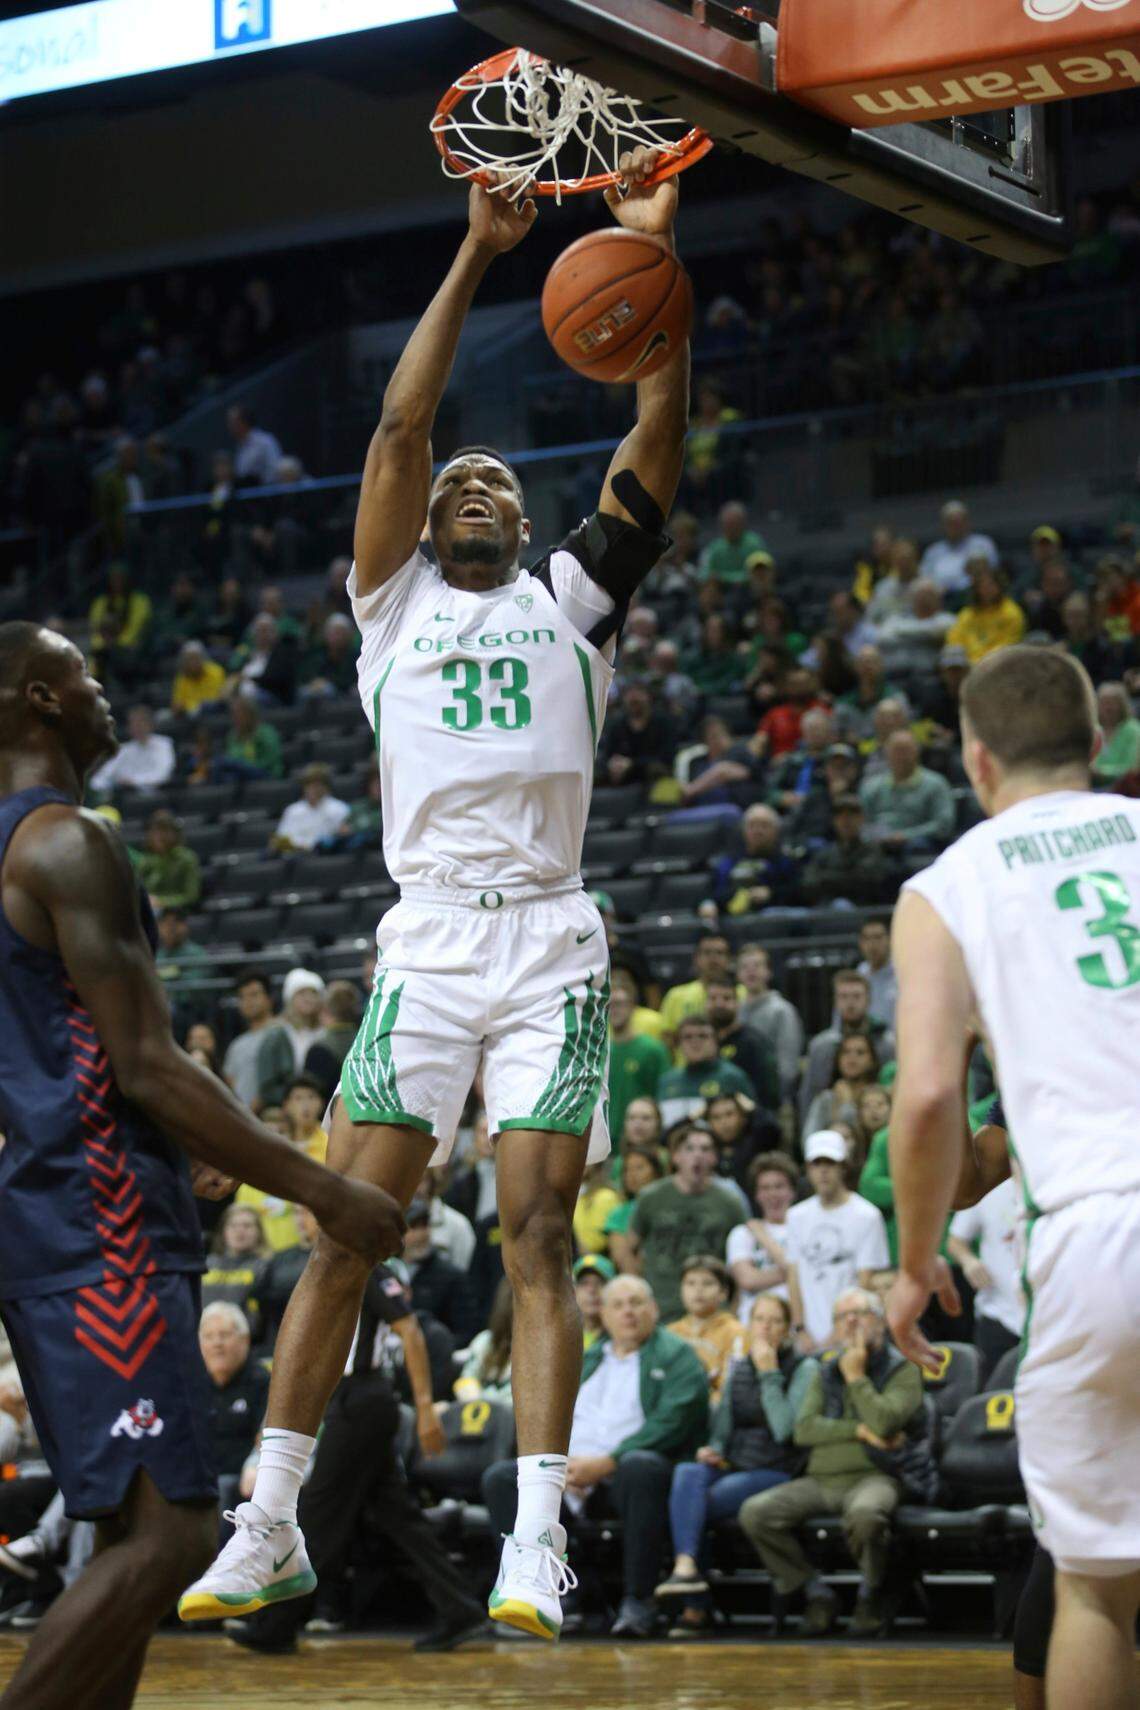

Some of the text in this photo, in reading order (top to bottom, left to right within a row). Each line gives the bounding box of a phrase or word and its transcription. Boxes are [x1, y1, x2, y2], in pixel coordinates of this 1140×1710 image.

[441, 657, 531, 731] 33
[998, 813, 1136, 870] PRITCHARD
[480, 890, 504, 910] O
